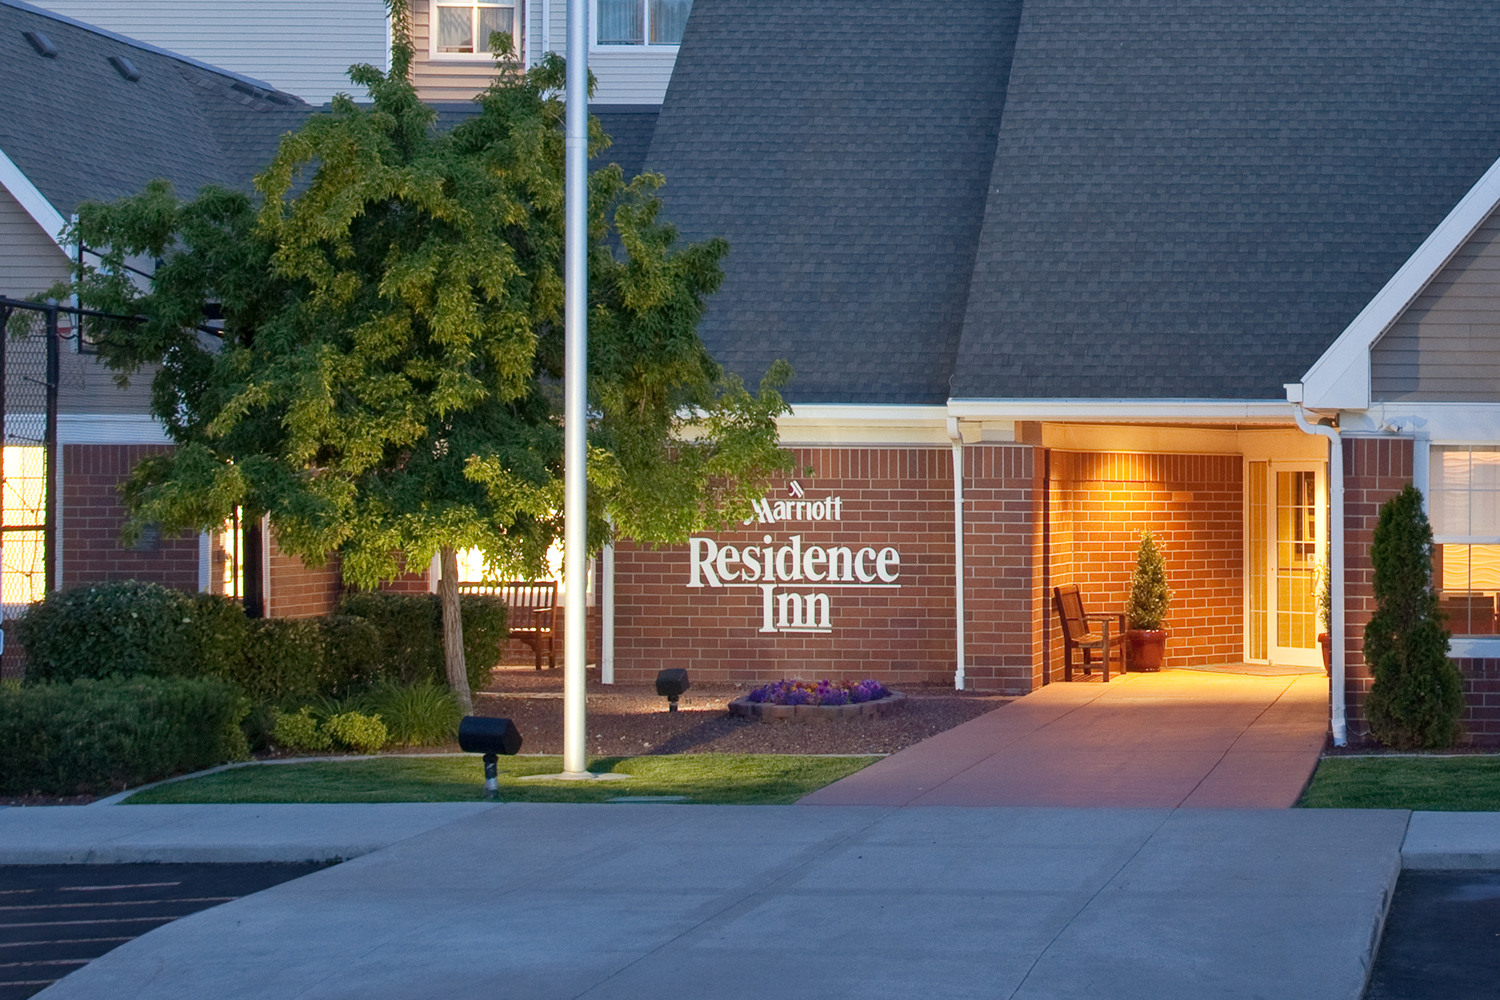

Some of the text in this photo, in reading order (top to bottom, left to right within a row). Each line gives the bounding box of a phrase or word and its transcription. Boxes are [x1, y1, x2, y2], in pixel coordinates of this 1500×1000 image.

[743, 496, 843, 526] Marriott
[686, 534, 900, 588] Residence
[758, 583, 832, 633] Inn
